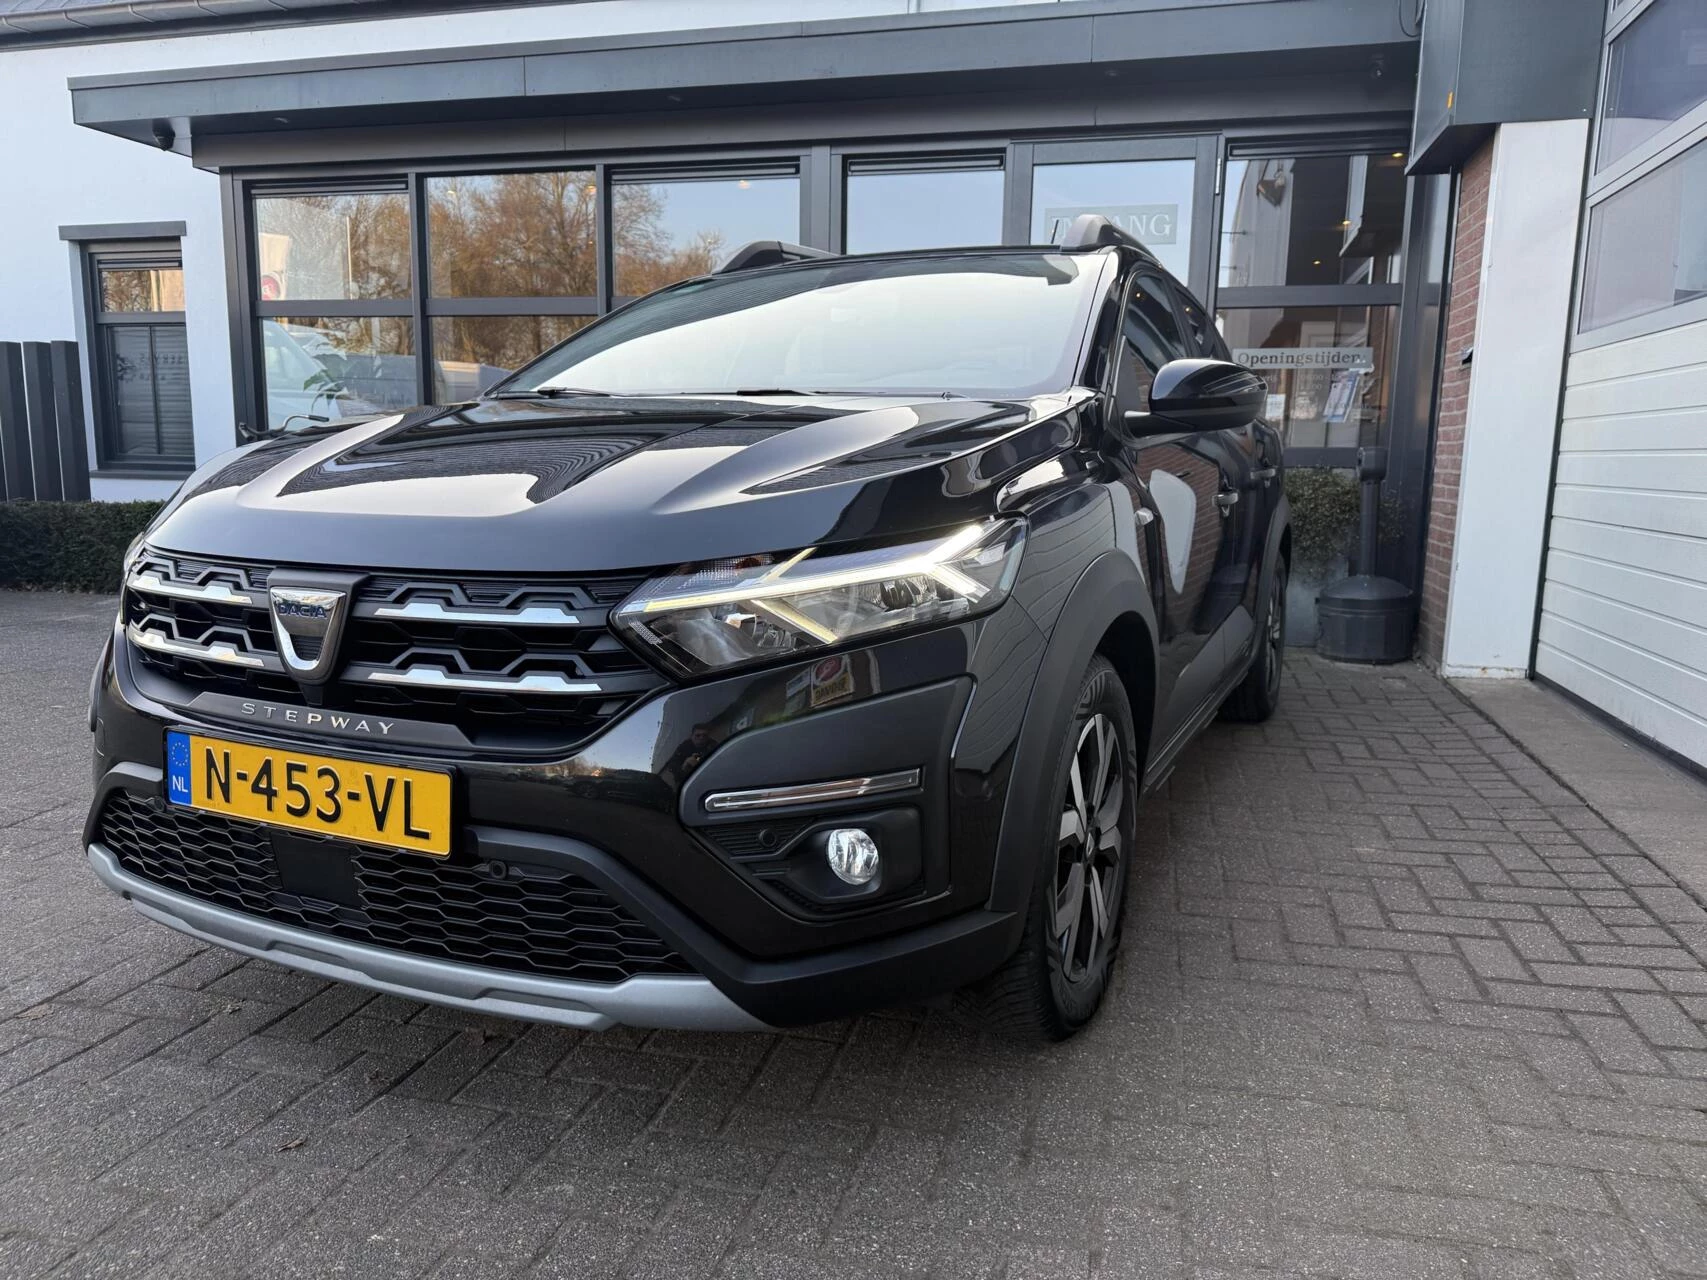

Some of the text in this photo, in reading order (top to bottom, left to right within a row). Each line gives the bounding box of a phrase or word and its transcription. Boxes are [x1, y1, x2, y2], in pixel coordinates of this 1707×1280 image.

[1050, 213, 1173, 241] INNG
[278, 603, 328, 619] DACIA
[241, 702, 394, 735] STEPWAY
[172, 776, 188, 793] NL
[205, 746, 432, 840] N-453-VL
